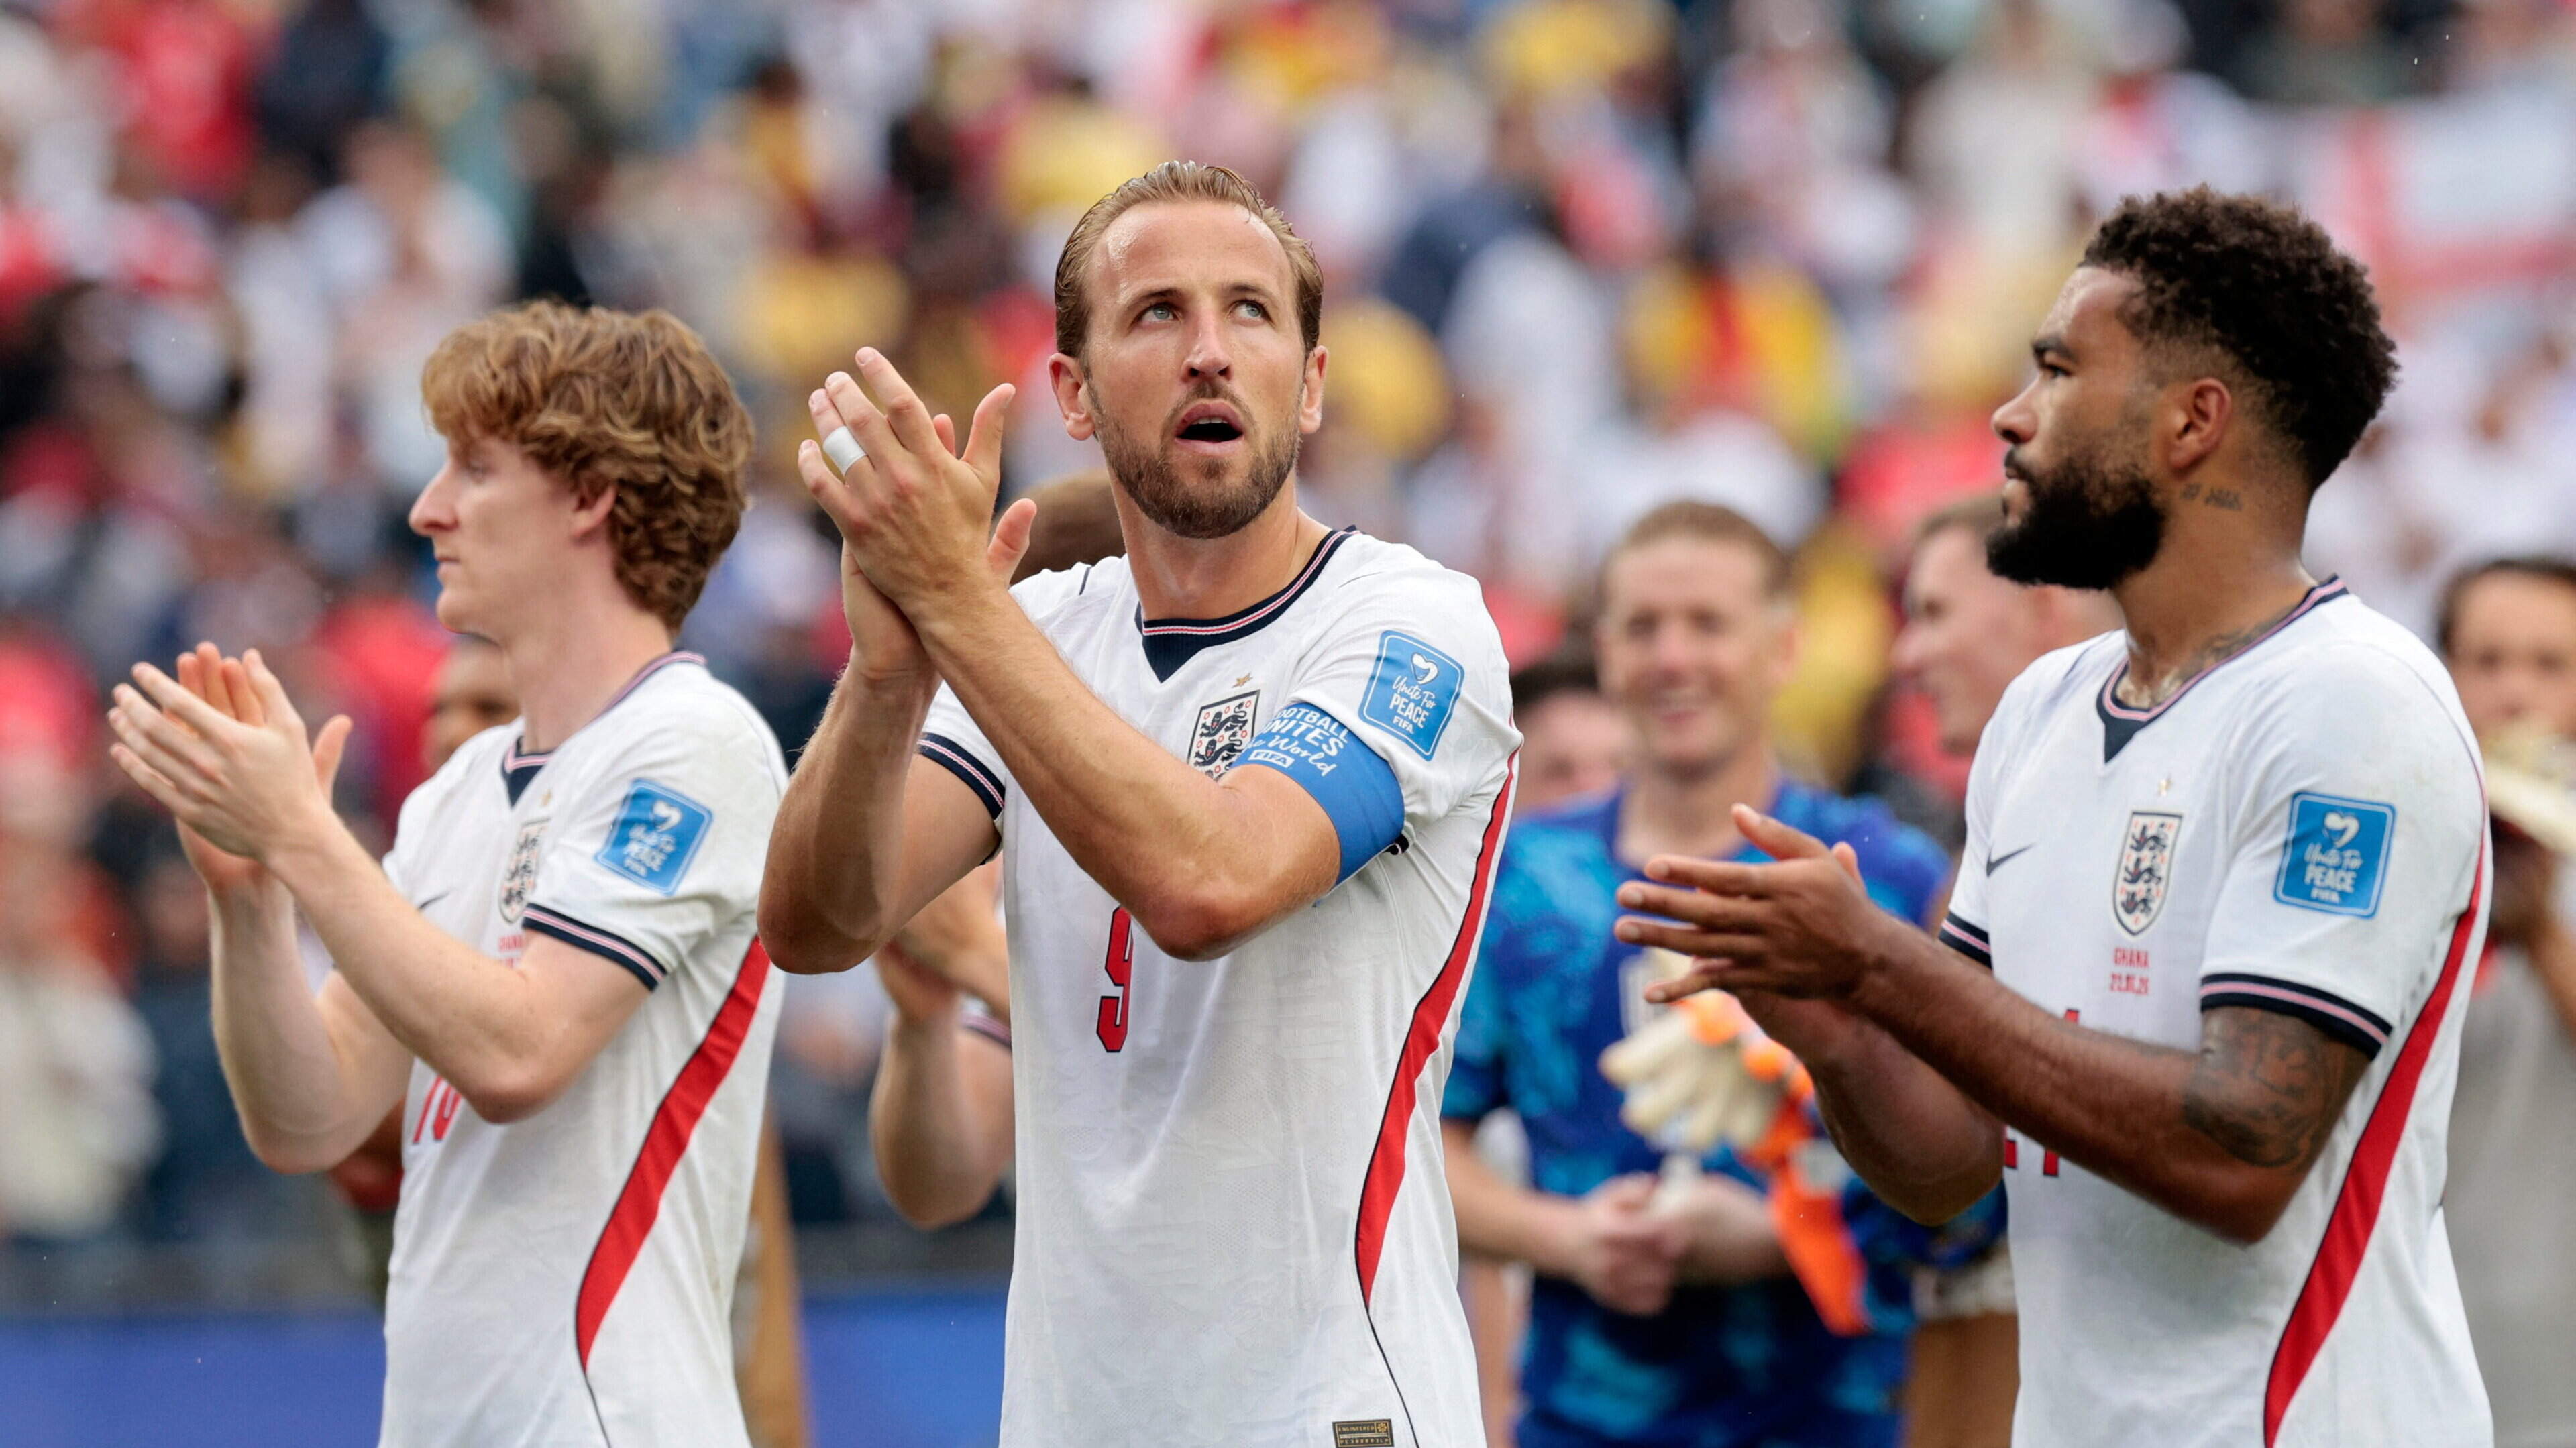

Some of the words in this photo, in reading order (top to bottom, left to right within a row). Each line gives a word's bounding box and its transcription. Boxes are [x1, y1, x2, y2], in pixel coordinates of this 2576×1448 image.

[1392, 675, 1421, 699] Unite
[1421, 691, 1436, 709] For
[1275, 707, 1349, 744] OOTBALL
[1389, 693, 1429, 728] PEACE
[1393, 715, 1413, 734] FIFA
[1252, 751, 1289, 766] FIFA
[1268, 735, 1337, 777] World
[2304, 863, 2357, 893] PEACE
[1096, 905, 1134, 1053] 9
